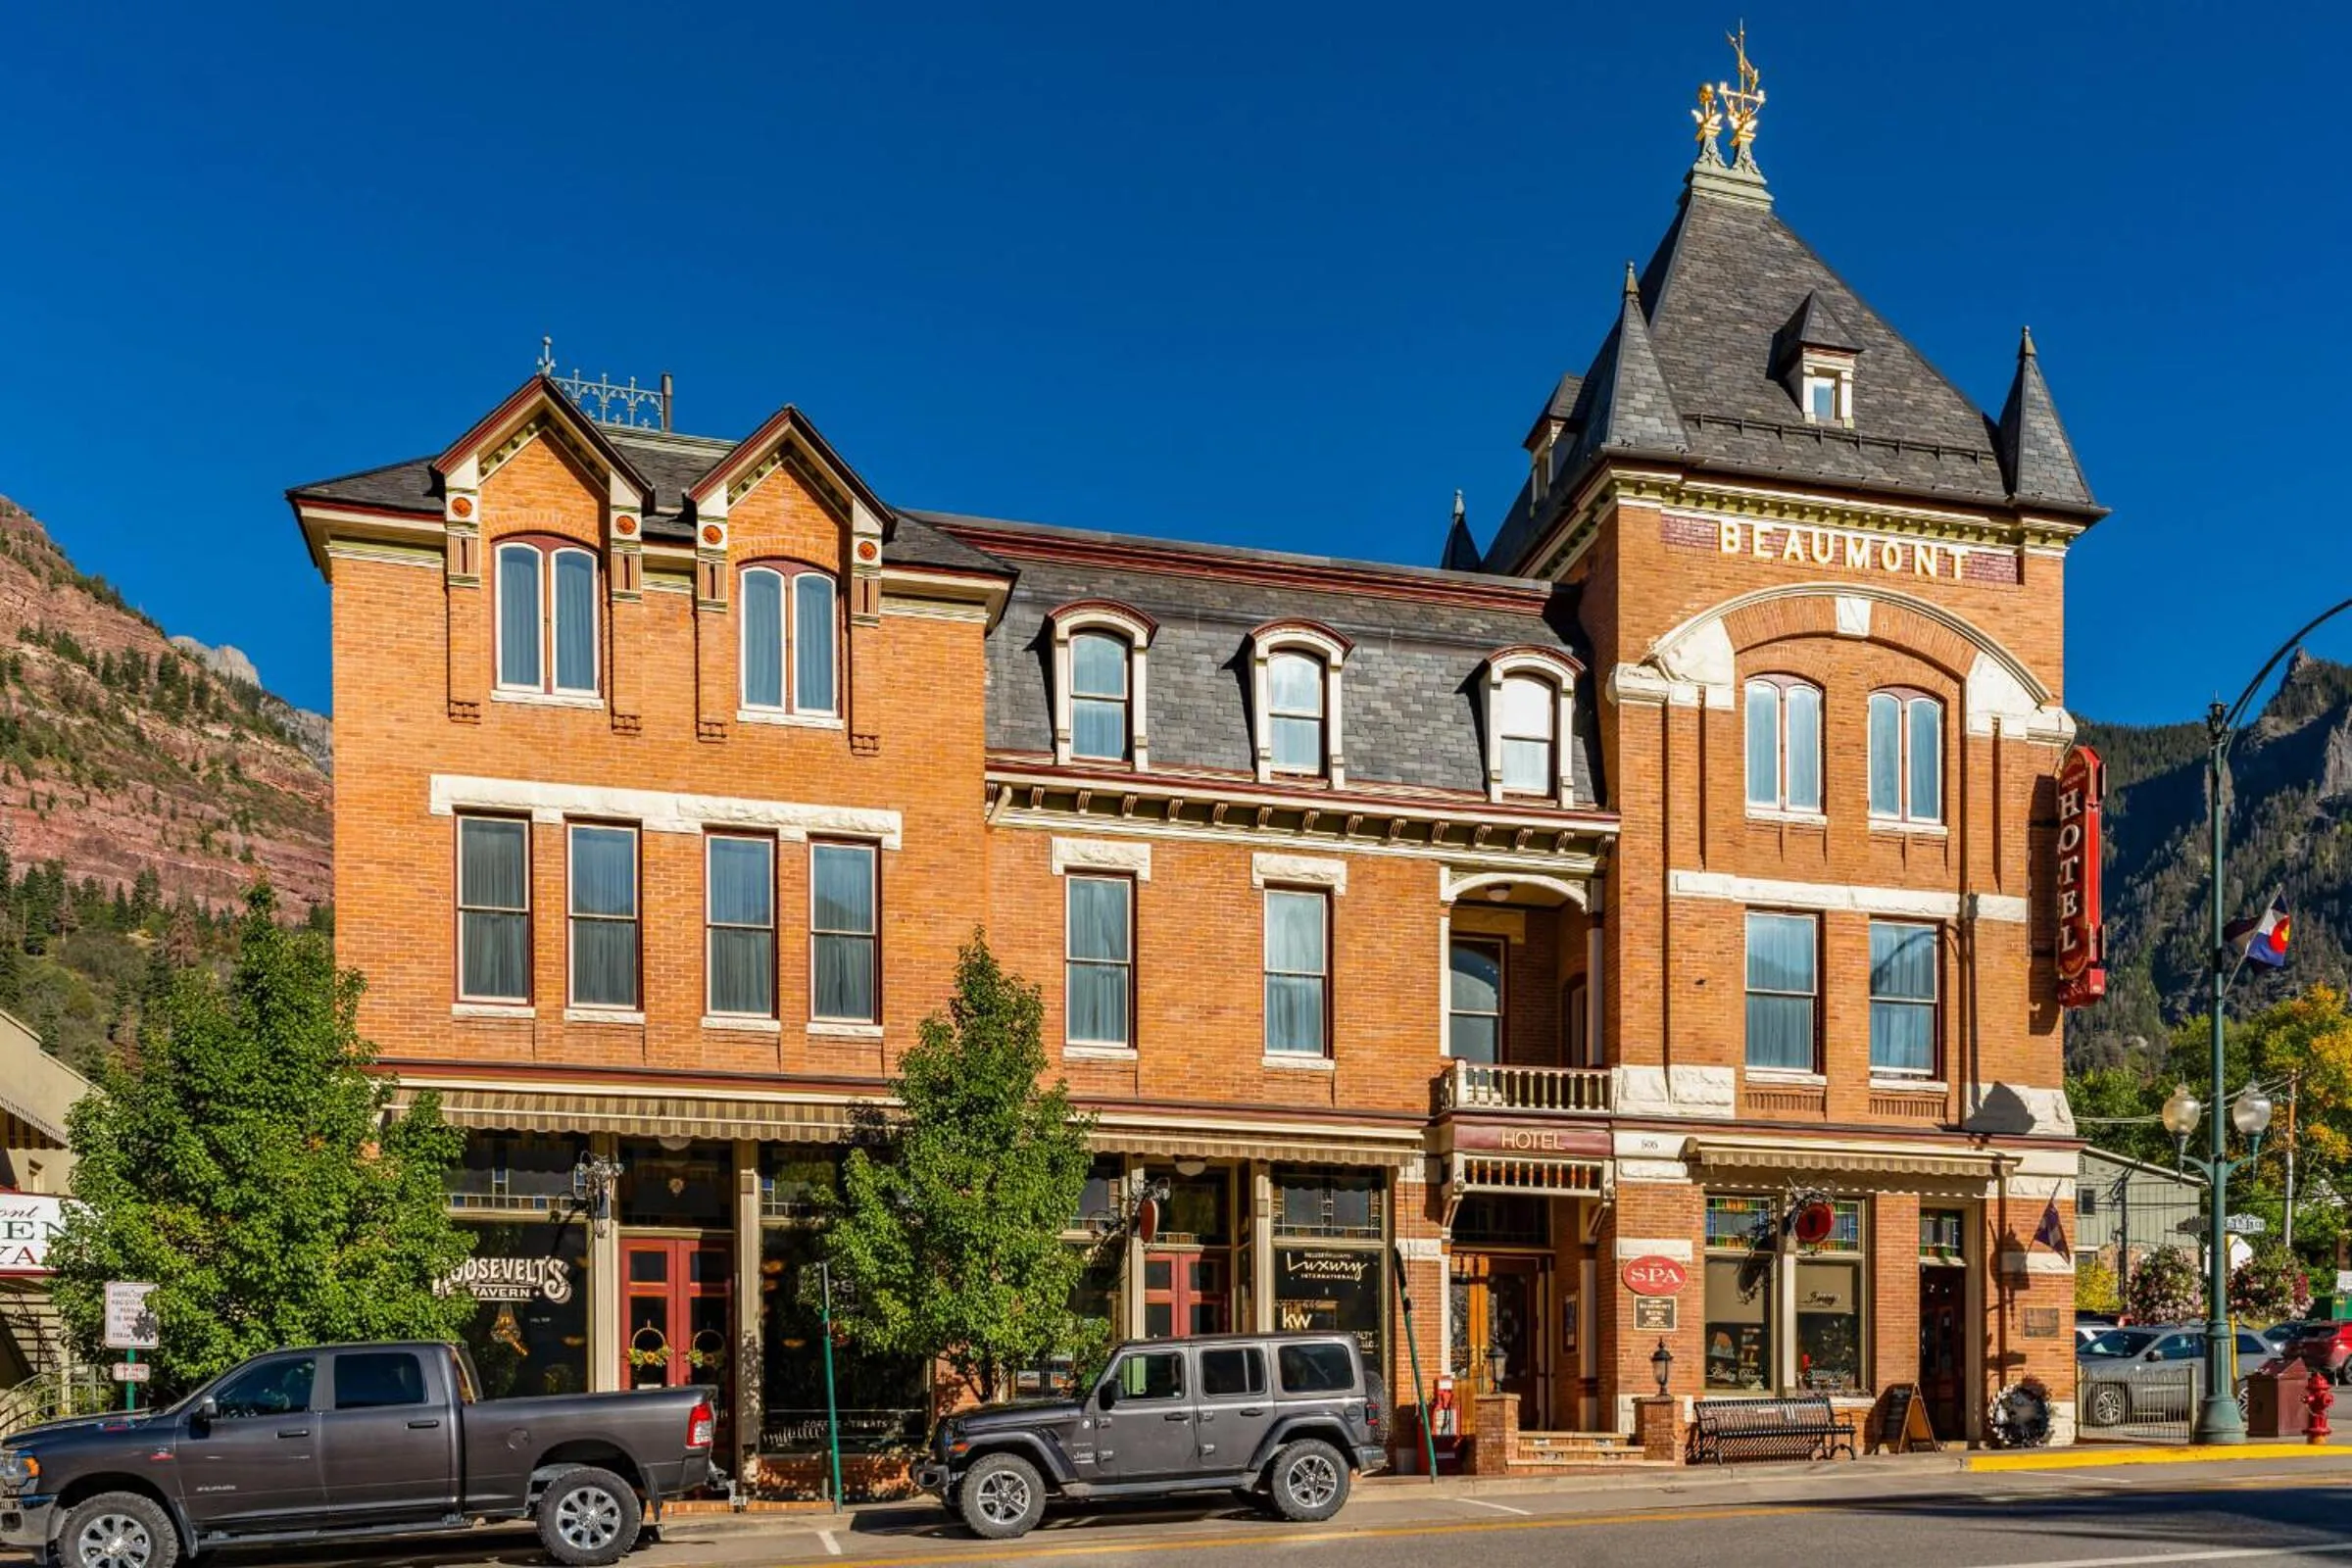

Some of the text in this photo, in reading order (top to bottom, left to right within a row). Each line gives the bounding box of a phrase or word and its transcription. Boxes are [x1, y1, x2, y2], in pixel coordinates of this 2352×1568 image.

[1719, 516, 1970, 580] BEAUMONT
[2059, 788, 2082, 953] HOTEL
[1501, 1131, 1566, 1151] HOTEL
[1286, 1251, 1368, 1282] Luxury
[1631, 1267, 1682, 1284] SPA
[469, 1286, 531, 1298] TAVERN
